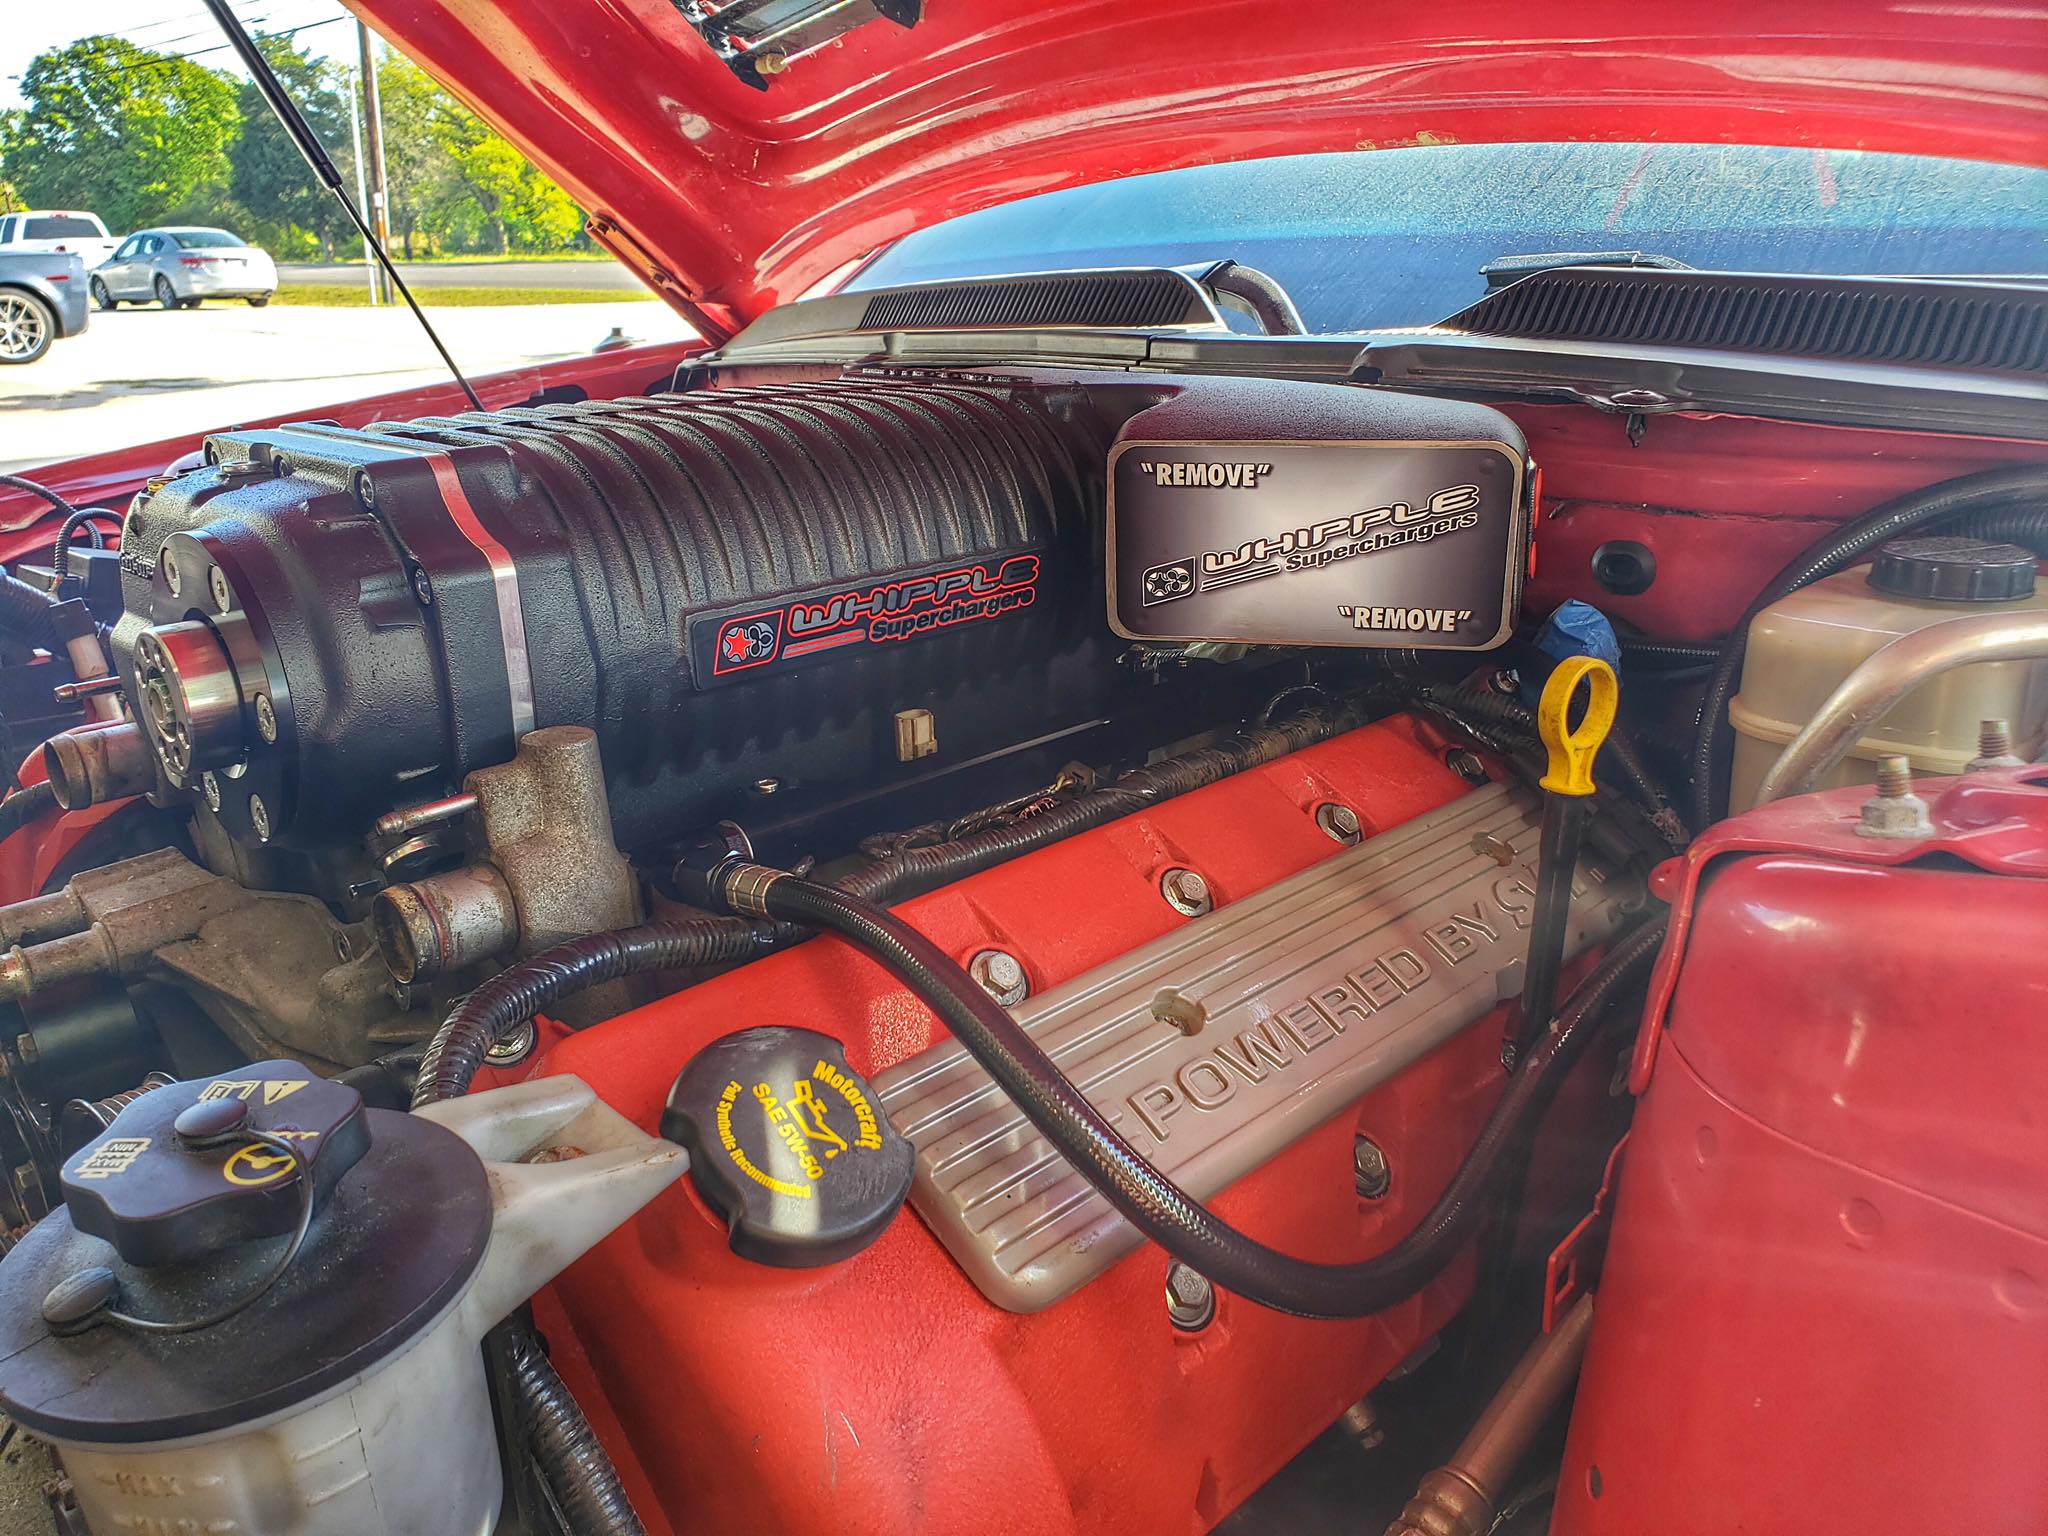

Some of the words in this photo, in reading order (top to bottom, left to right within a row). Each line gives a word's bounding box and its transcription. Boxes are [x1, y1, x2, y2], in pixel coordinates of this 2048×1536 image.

[1202, 485, 1480, 573] WHIPPLE
[1285, 511, 1477, 571] Superchargers
[788, 556, 1040, 636] WHIPPLE
[868, 586, 1036, 643] Superchargers
[1126, 947, 1432, 1145] POWERED
[1423, 901, 1500, 968] BY
[717, 1100, 736, 1150] Synthetic
[722, 1081, 742, 1101] Full
[813, 1060, 882, 1149] Motorcraft
[753, 1083, 788, 1124] SAE
[778, 1123, 823, 1179] 5W-50
[730, 1148, 811, 1198] Recommended
